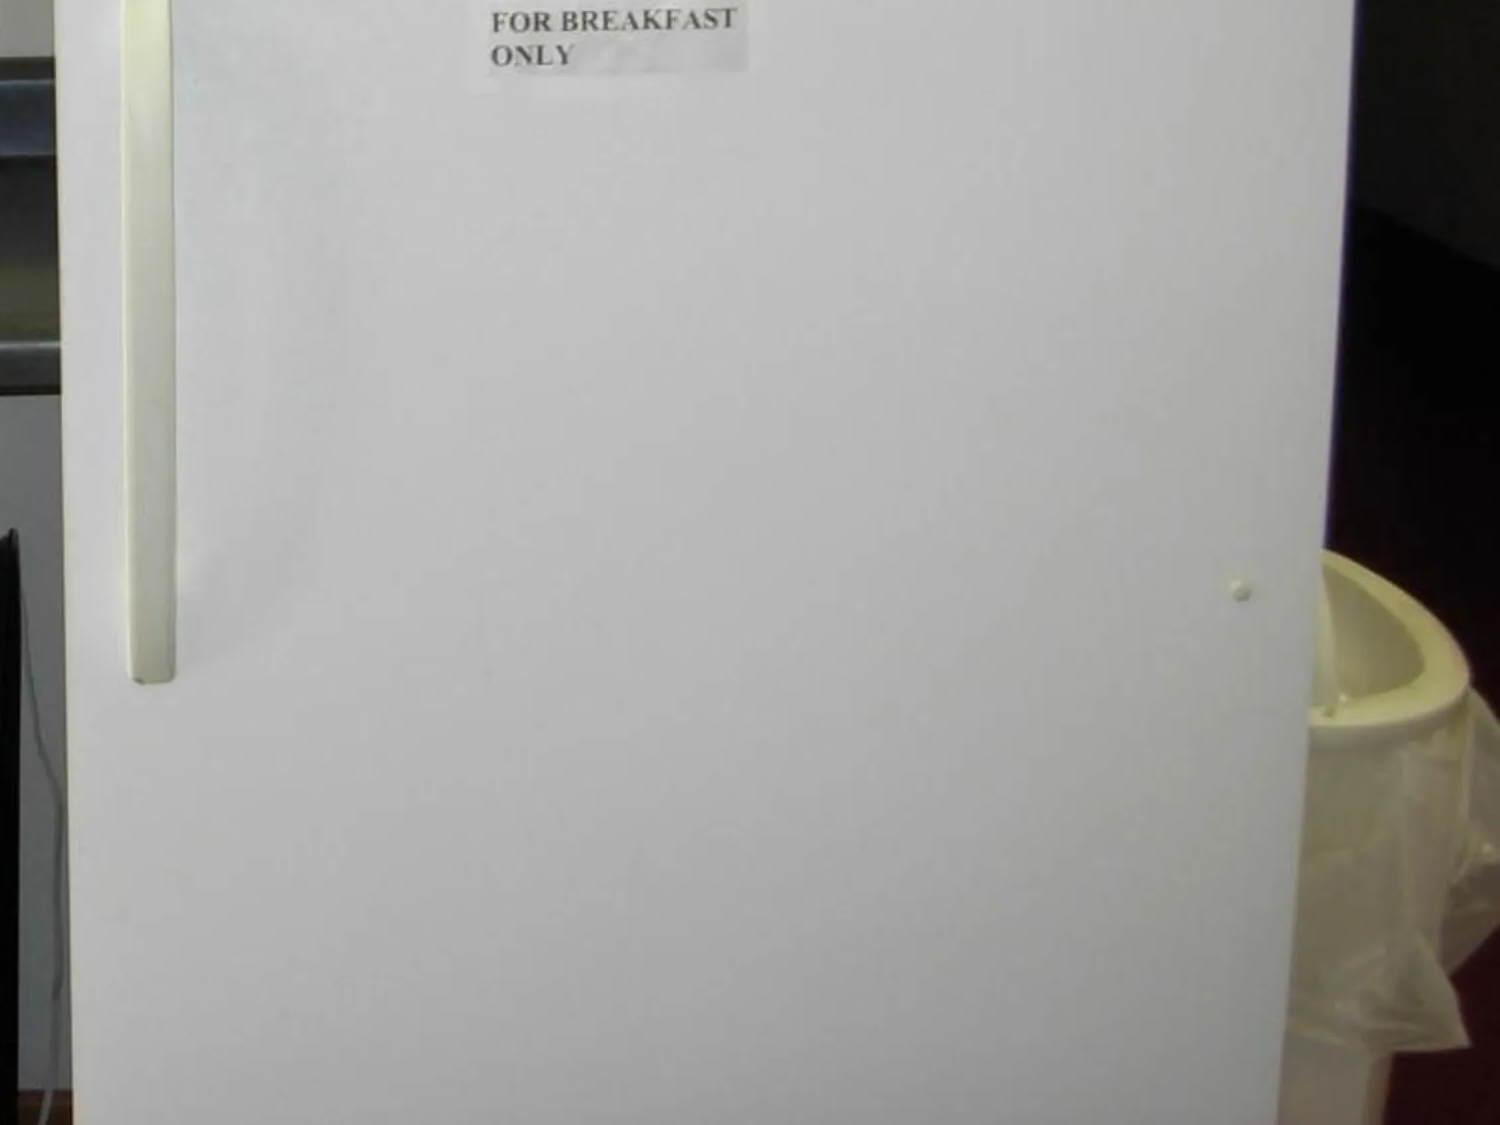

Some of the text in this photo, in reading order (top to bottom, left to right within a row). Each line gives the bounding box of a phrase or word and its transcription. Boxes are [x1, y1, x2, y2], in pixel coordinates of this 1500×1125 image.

[491, 7, 738, 33] FOR BREAKFAST
[490, 44, 575, 67] ONLY
